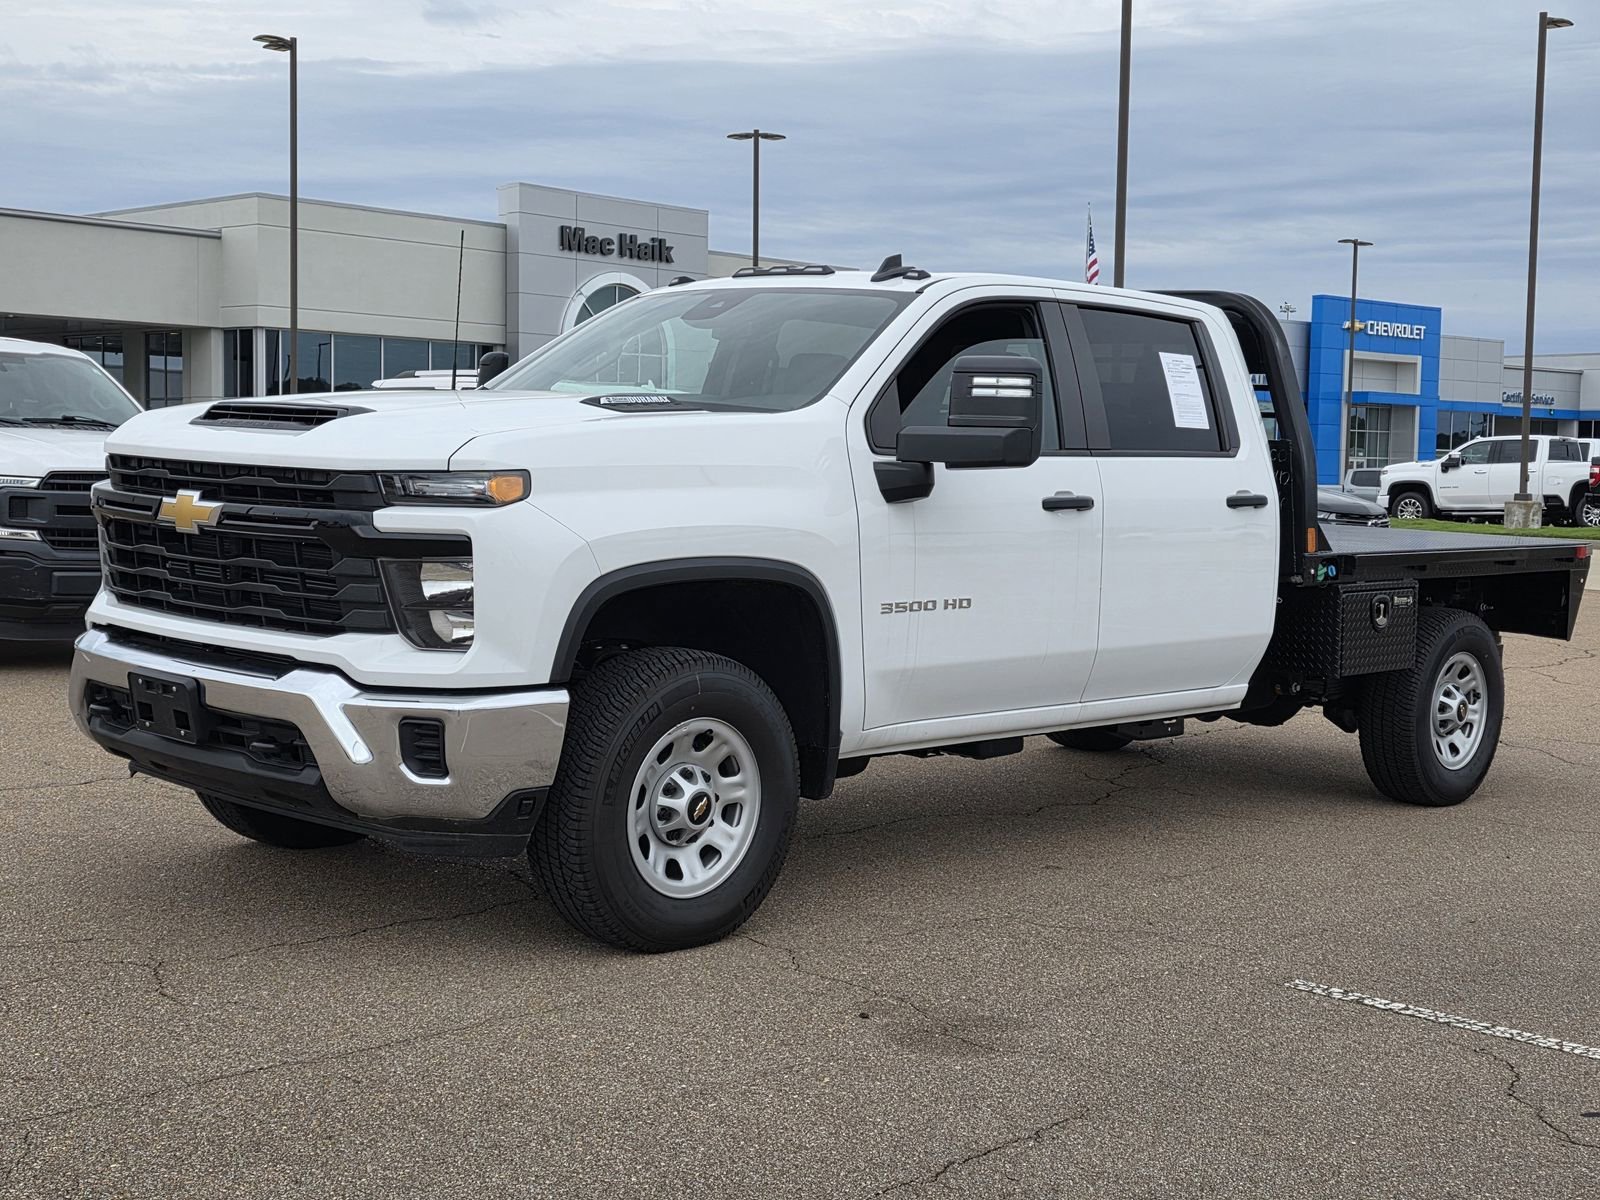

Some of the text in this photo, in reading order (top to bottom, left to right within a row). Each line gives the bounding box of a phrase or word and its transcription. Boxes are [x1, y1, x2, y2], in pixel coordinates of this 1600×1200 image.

[559, 225, 675, 263] Mac Haik
[1367, 320, 1426, 340] CHEVROLET
[1502, 391, 1555, 406] Certifi Service
[880, 598, 972, 614] 3500 HD
[609, 702, 662, 783] MICHELIN
